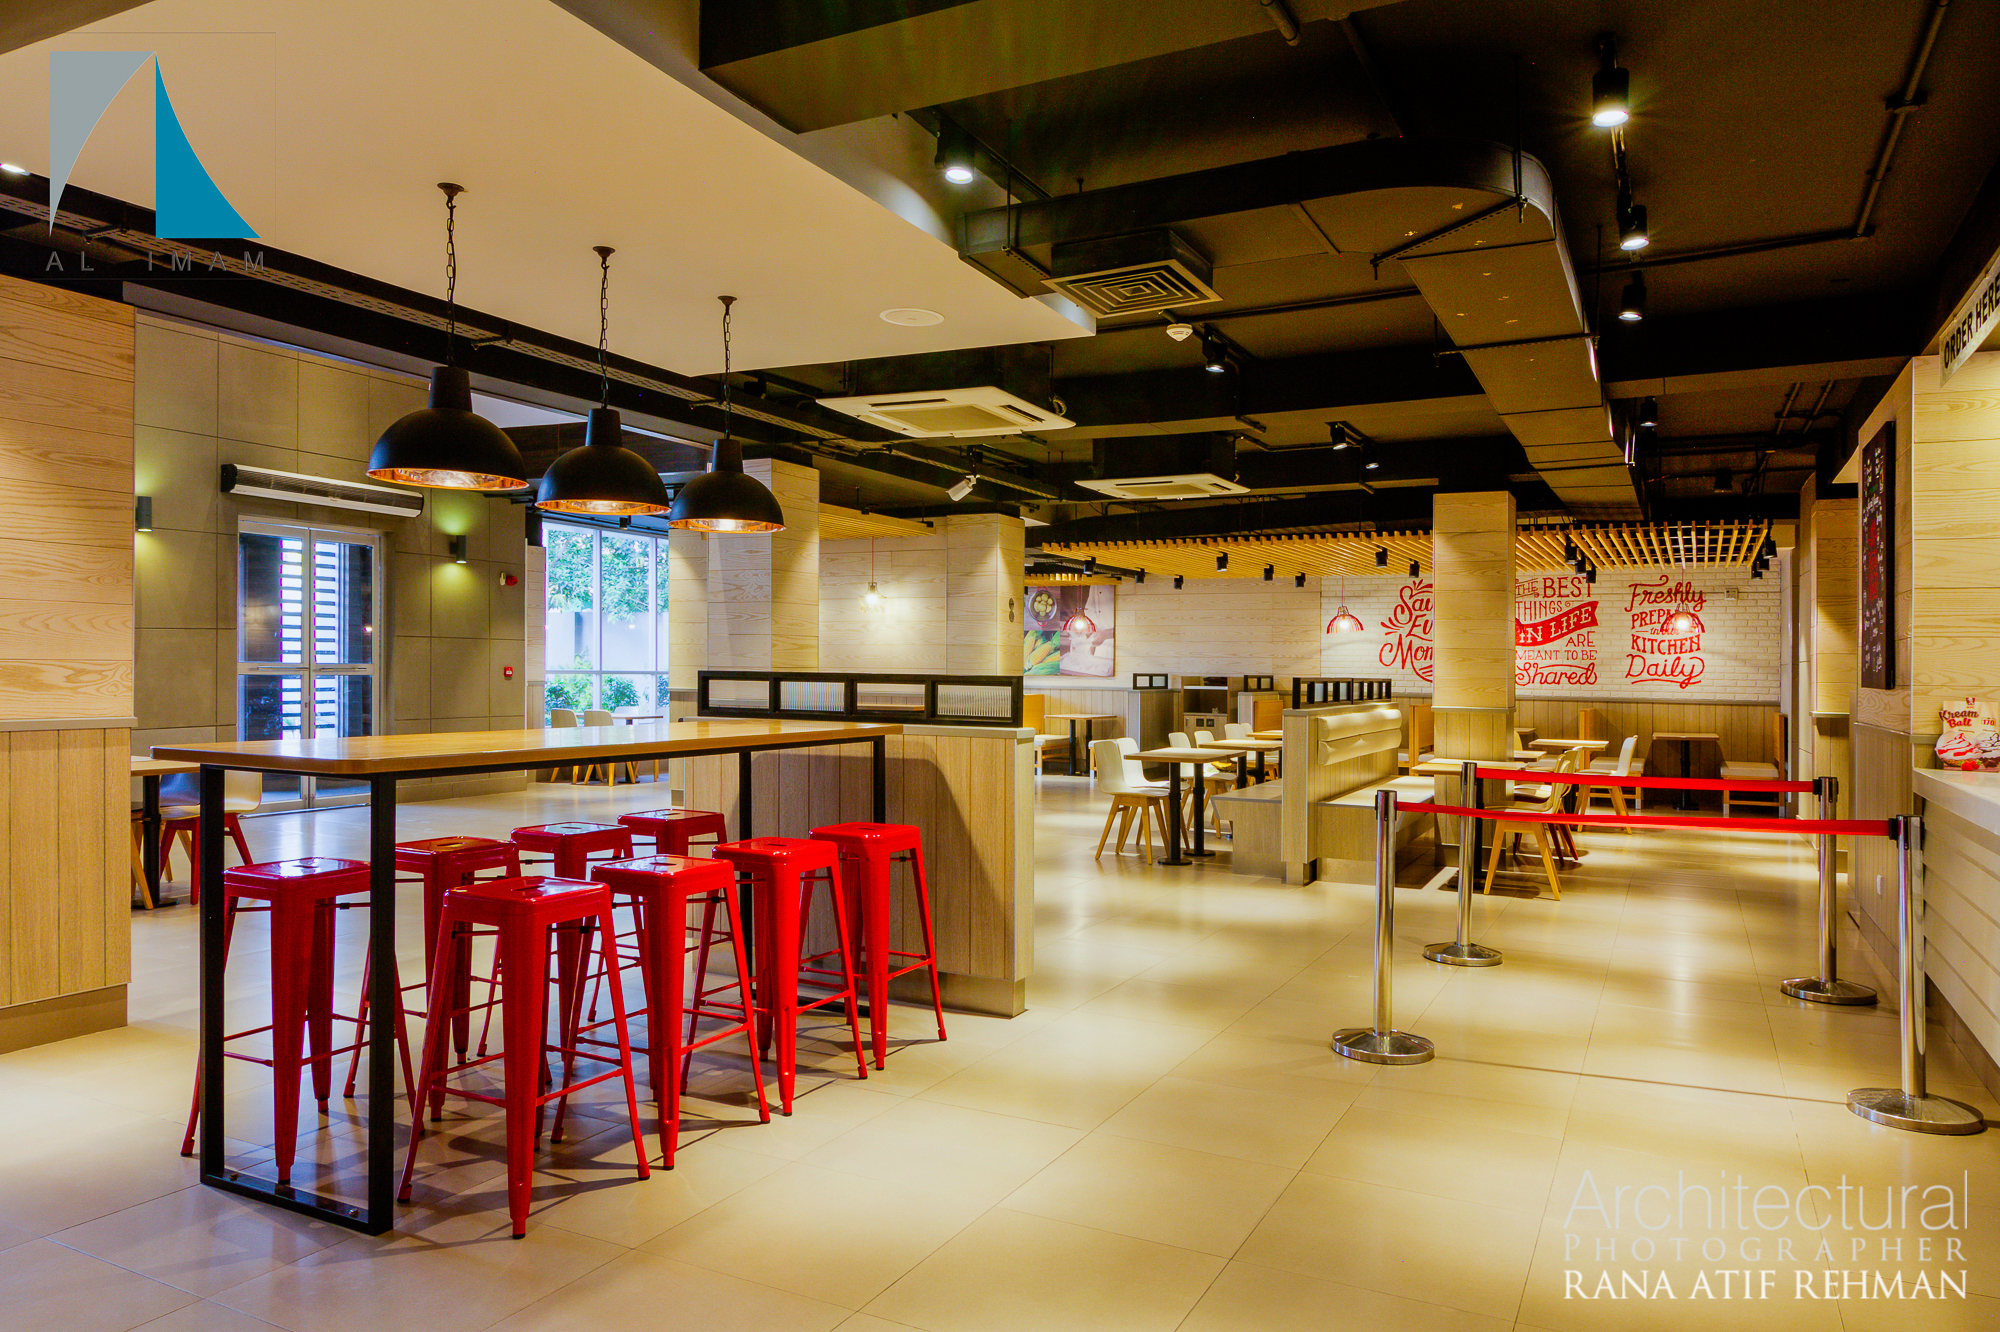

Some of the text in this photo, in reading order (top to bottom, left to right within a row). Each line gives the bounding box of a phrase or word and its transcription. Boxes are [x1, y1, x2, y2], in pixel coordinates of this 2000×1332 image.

[1944, 272, 2000, 369] ORDER HERE
[1516, 577, 1591, 598] THE BEST
[1624, 575, 1707, 612] Freshly
[1516, 601, 1562, 621] THINGS
[1550, 606, 1592, 638] LIFE
[1565, 631, 1596, 647] ARE
[1631, 633, 1701, 655] KITCHEN
[1516, 650, 1597, 660] MEANT TO BE
[1515, 662, 1597, 686] Shared
[1625, 654, 1705, 689] Daily
[1938, 709, 1979, 722] Kream
[1947, 717, 1972, 729] Ball
